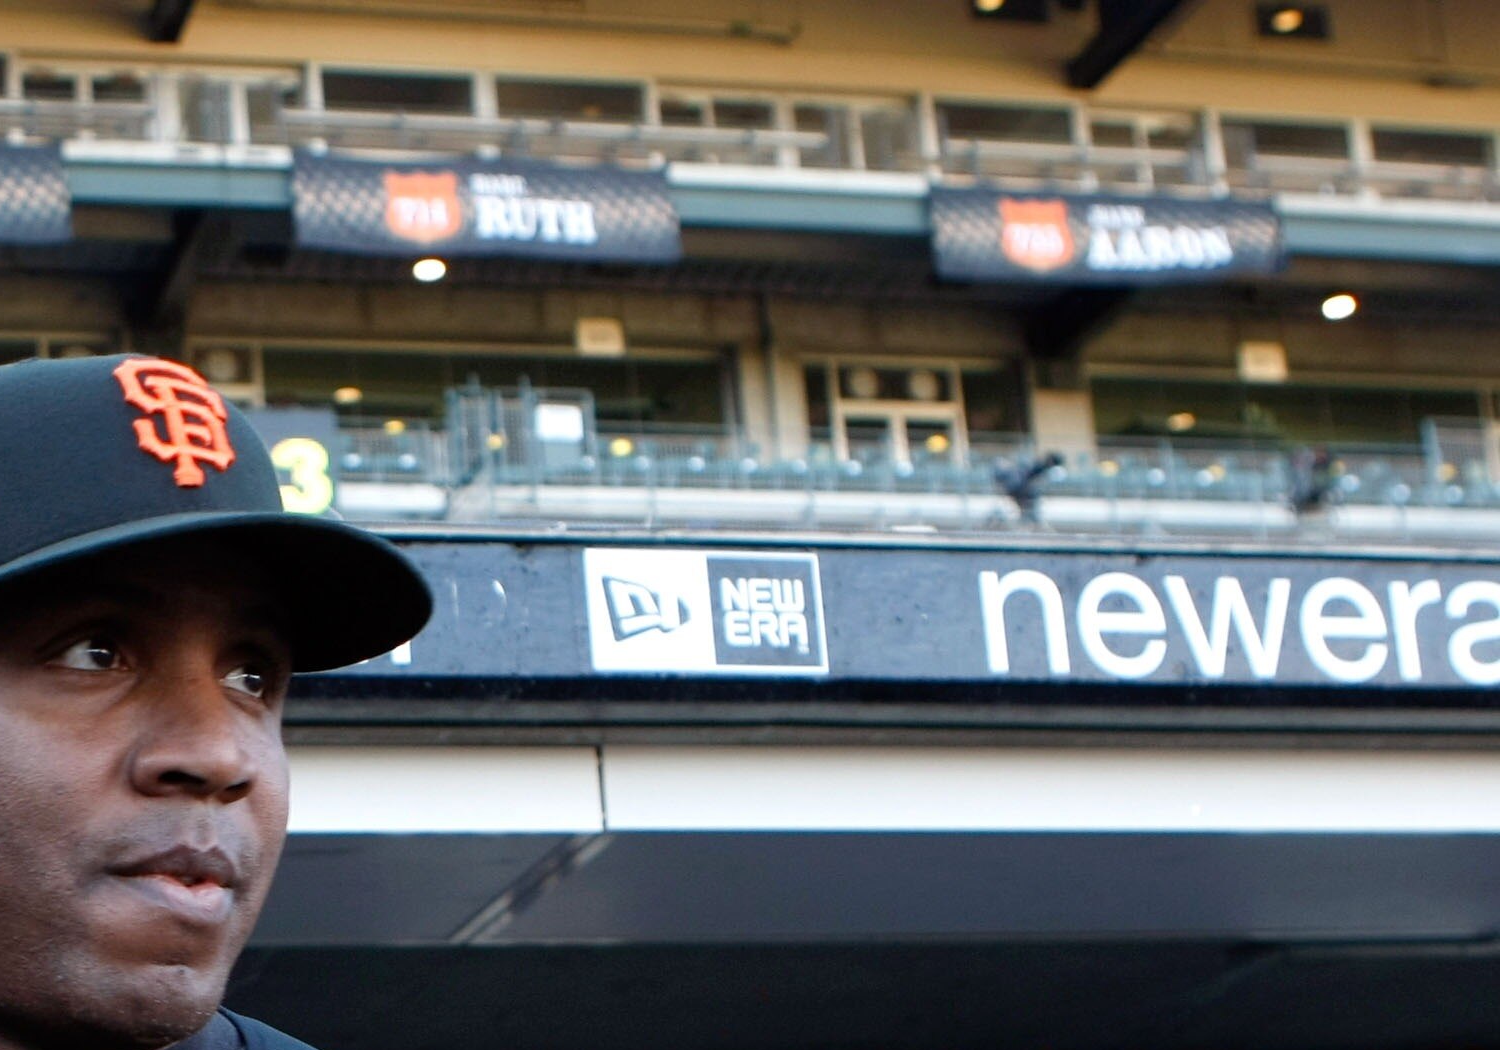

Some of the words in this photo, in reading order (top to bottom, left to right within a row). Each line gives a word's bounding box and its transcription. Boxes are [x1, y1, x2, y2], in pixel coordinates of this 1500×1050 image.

[476, 197, 597, 243] RUTH
[1088, 225, 1233, 271] AARON
[271, 437, 333, 514] 3
[720, 577, 805, 612] NEW
[724, 610, 808, 648] ERA
